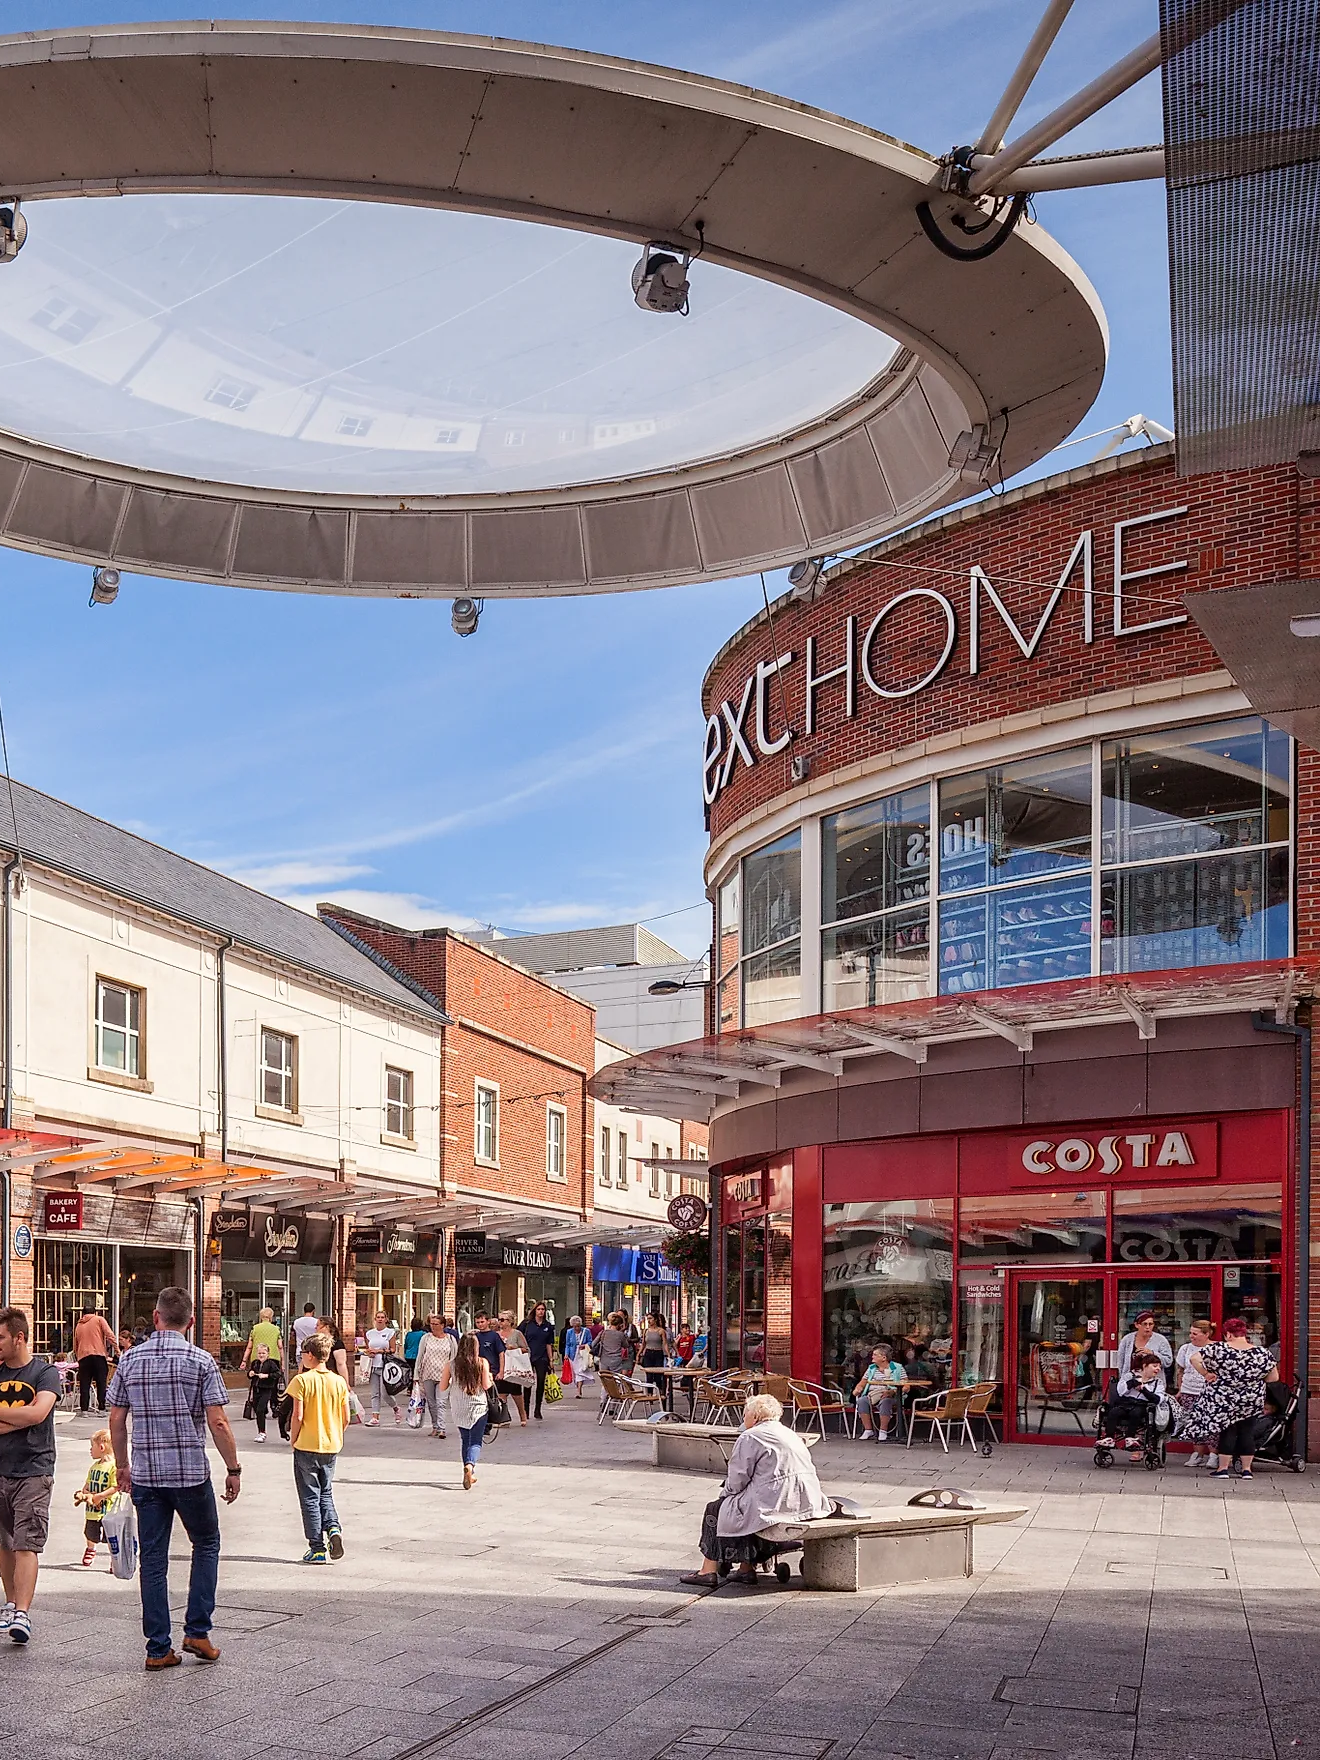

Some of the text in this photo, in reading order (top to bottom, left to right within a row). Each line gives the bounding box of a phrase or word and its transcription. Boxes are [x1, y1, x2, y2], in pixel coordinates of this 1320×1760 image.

[703, 506, 1188, 804] ext HOME
[1021, 1131, 1196, 1175] COSTA
[49, 1198, 77, 1206] BAKERY
[671, 1197, 694, 1211] COSTA
[49, 1214, 78, 1223] CAFE
[455, 1238, 479, 1246] RIVER
[878, 1236, 902, 1247] COSTA
[1119, 1236, 1238, 1262] COSTA
[503, 1247, 552, 1268] RIVER ISLAND
[643, 1260, 656, 1280] S
[387, 1362, 398, 1380] JD
